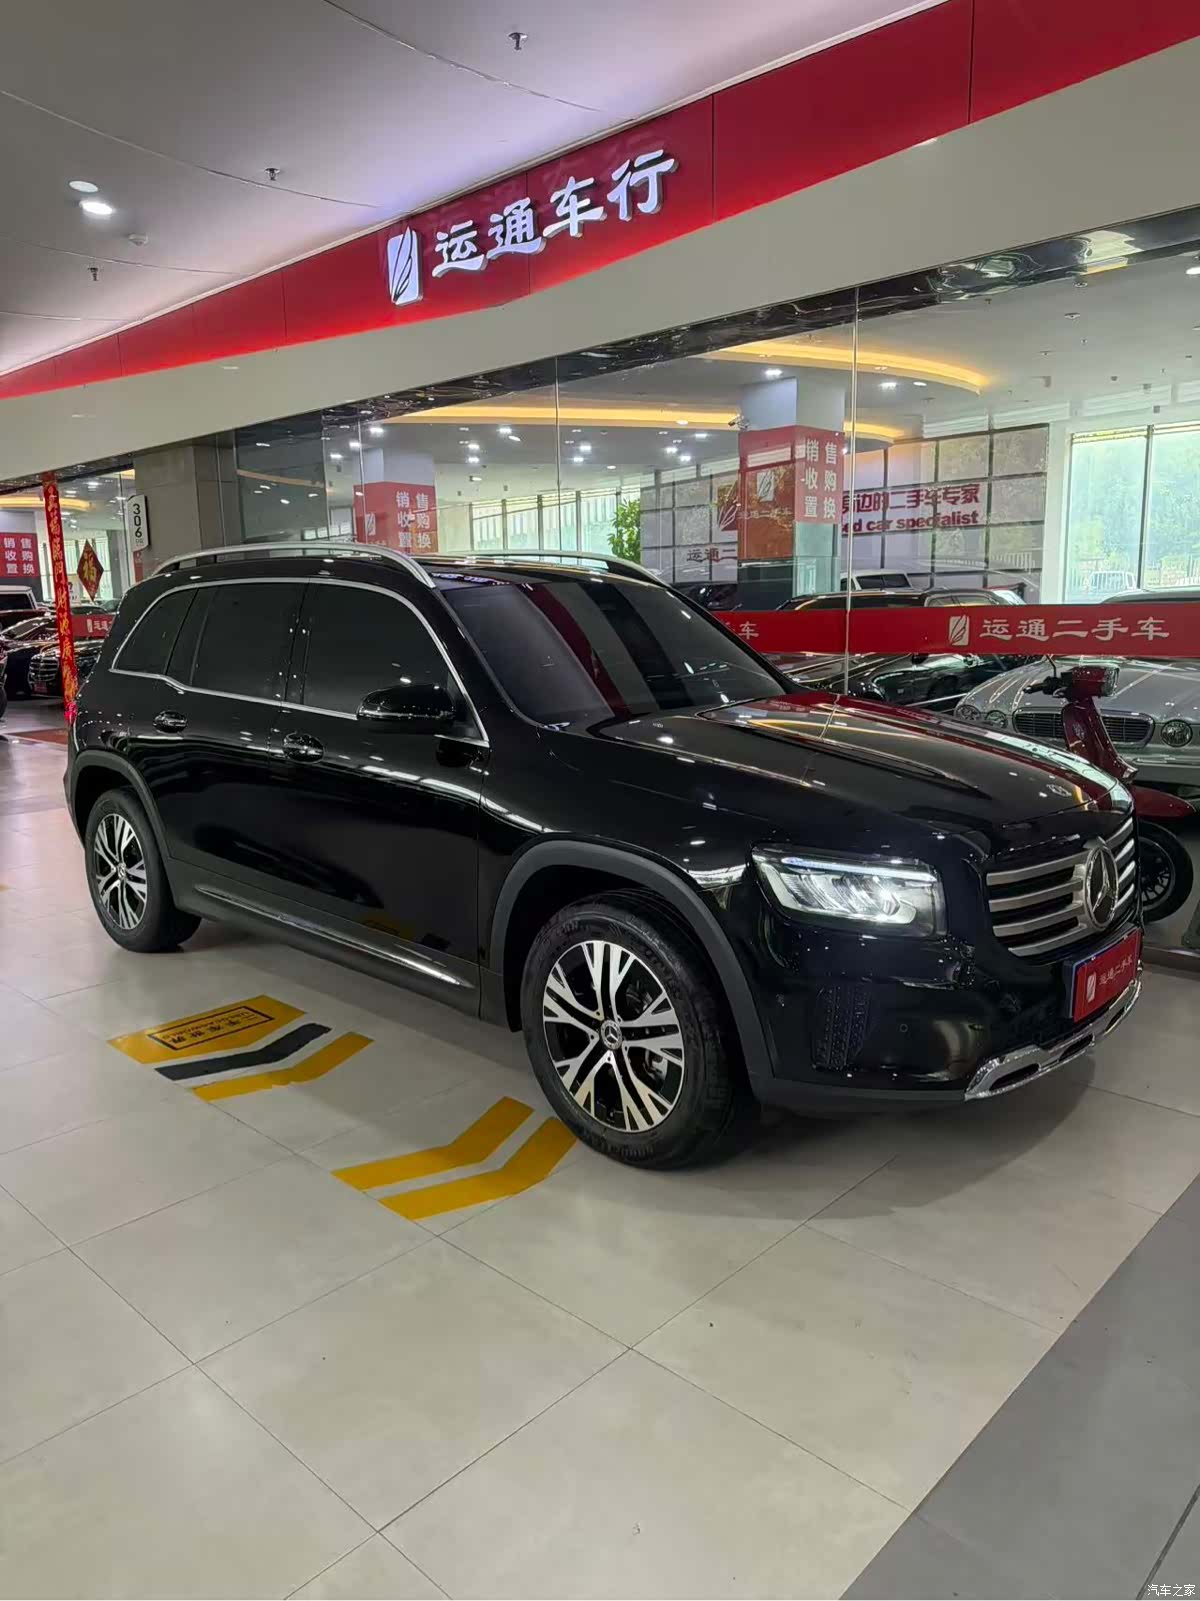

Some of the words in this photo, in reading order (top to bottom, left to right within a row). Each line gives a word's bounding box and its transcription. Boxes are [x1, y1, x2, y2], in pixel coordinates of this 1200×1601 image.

[432, 148, 679, 278] 运通车行
[805, 438, 837, 466] 销售
[804, 466, 837, 492] 收购
[395, 490, 429, 512] 销售
[803, 496, 837, 520] 置换
[132, 503, 143, 538] 306
[397, 511, 430, 529] 收购
[866, 519, 893, 532] car
[896, 510, 980, 530] specialist
[3, 537, 32, 550] 销售
[398, 531, 432, 548] 置换
[5, 550, 34, 562] 收购
[6, 563, 35, 575] 置换
[979, 616, 1170, 642] 运通二手车
